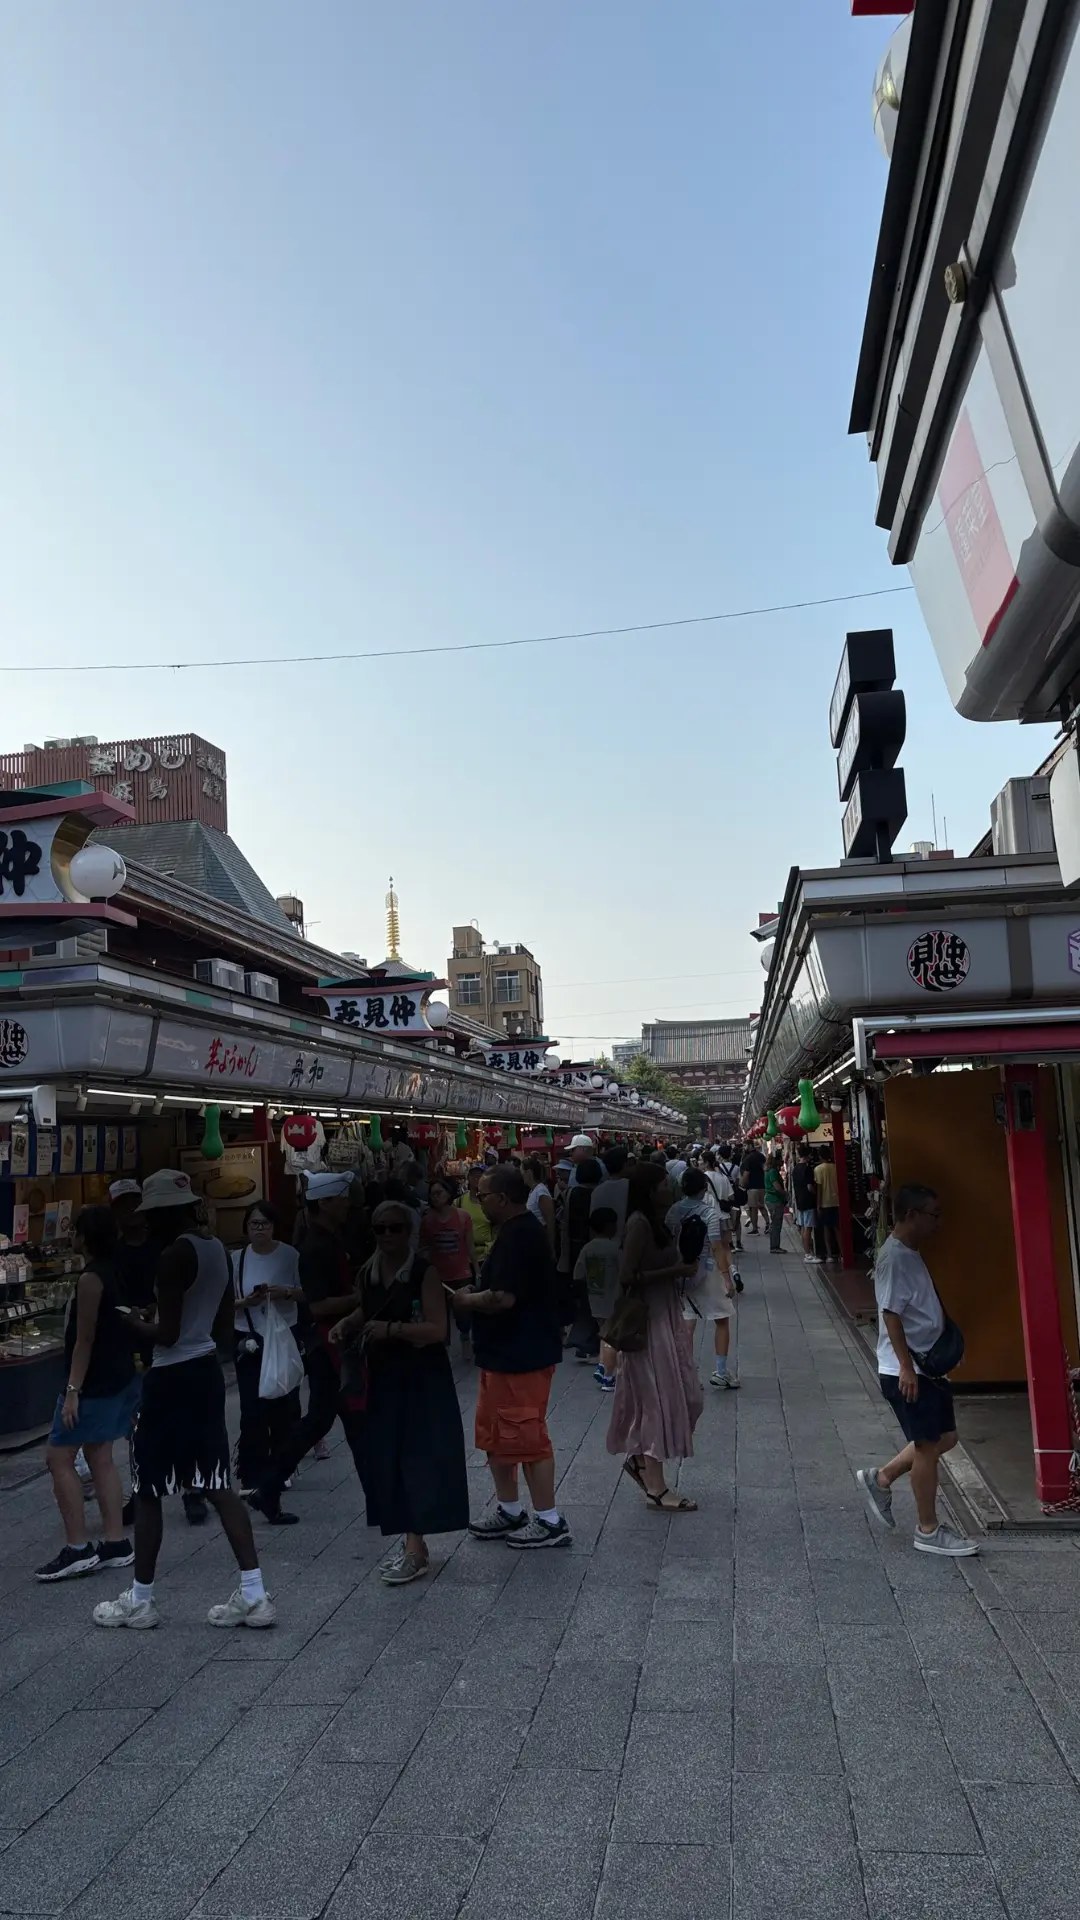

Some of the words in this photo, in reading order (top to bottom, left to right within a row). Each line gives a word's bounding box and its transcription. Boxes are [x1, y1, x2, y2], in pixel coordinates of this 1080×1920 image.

[87, 739, 186, 777] 釜めし
[288, 1052, 325, 1089] 舟和
